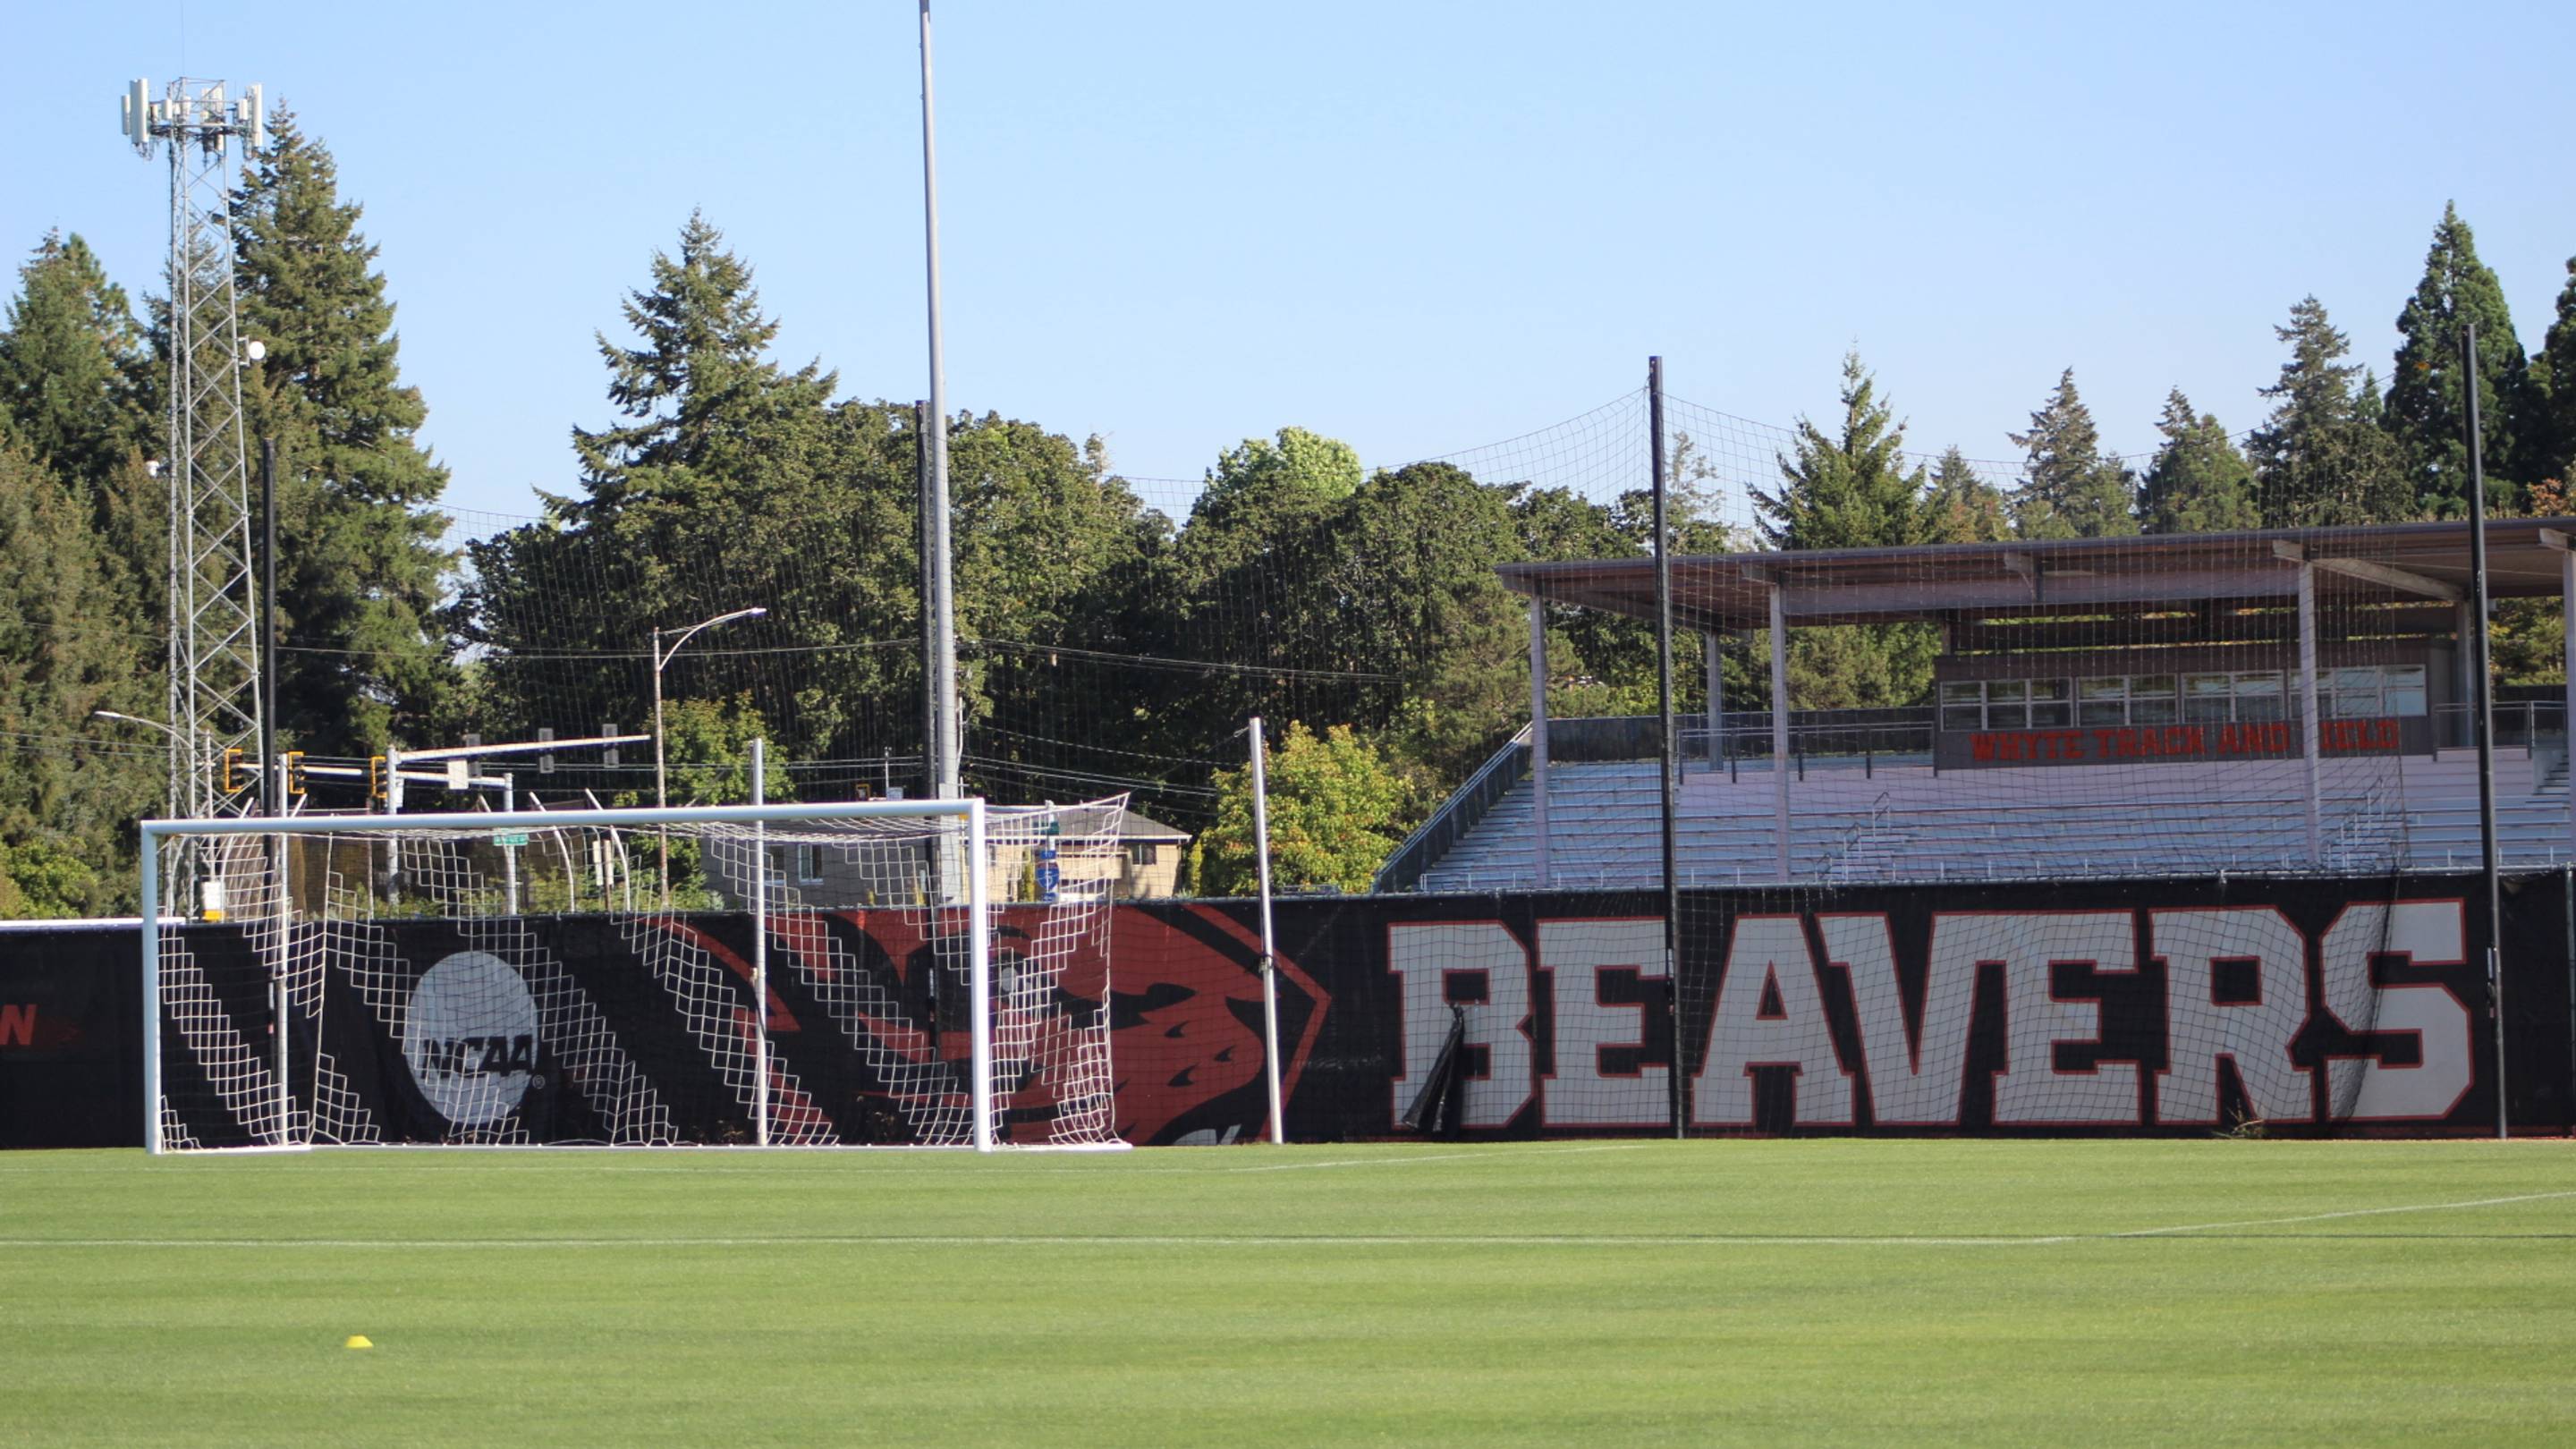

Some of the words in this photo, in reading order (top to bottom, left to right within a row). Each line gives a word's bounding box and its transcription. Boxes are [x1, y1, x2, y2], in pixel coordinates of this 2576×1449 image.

[1970, 731, 2085, 761] WHYTE
[2094, 724, 2205, 758] TRACK
[2218, 722, 2291, 756] AND
[2318, 718, 2401, 751] IELD
[1388, 897, 2475, 1130] BEAVERS
[419, 1035, 534, 1079] NCAA
